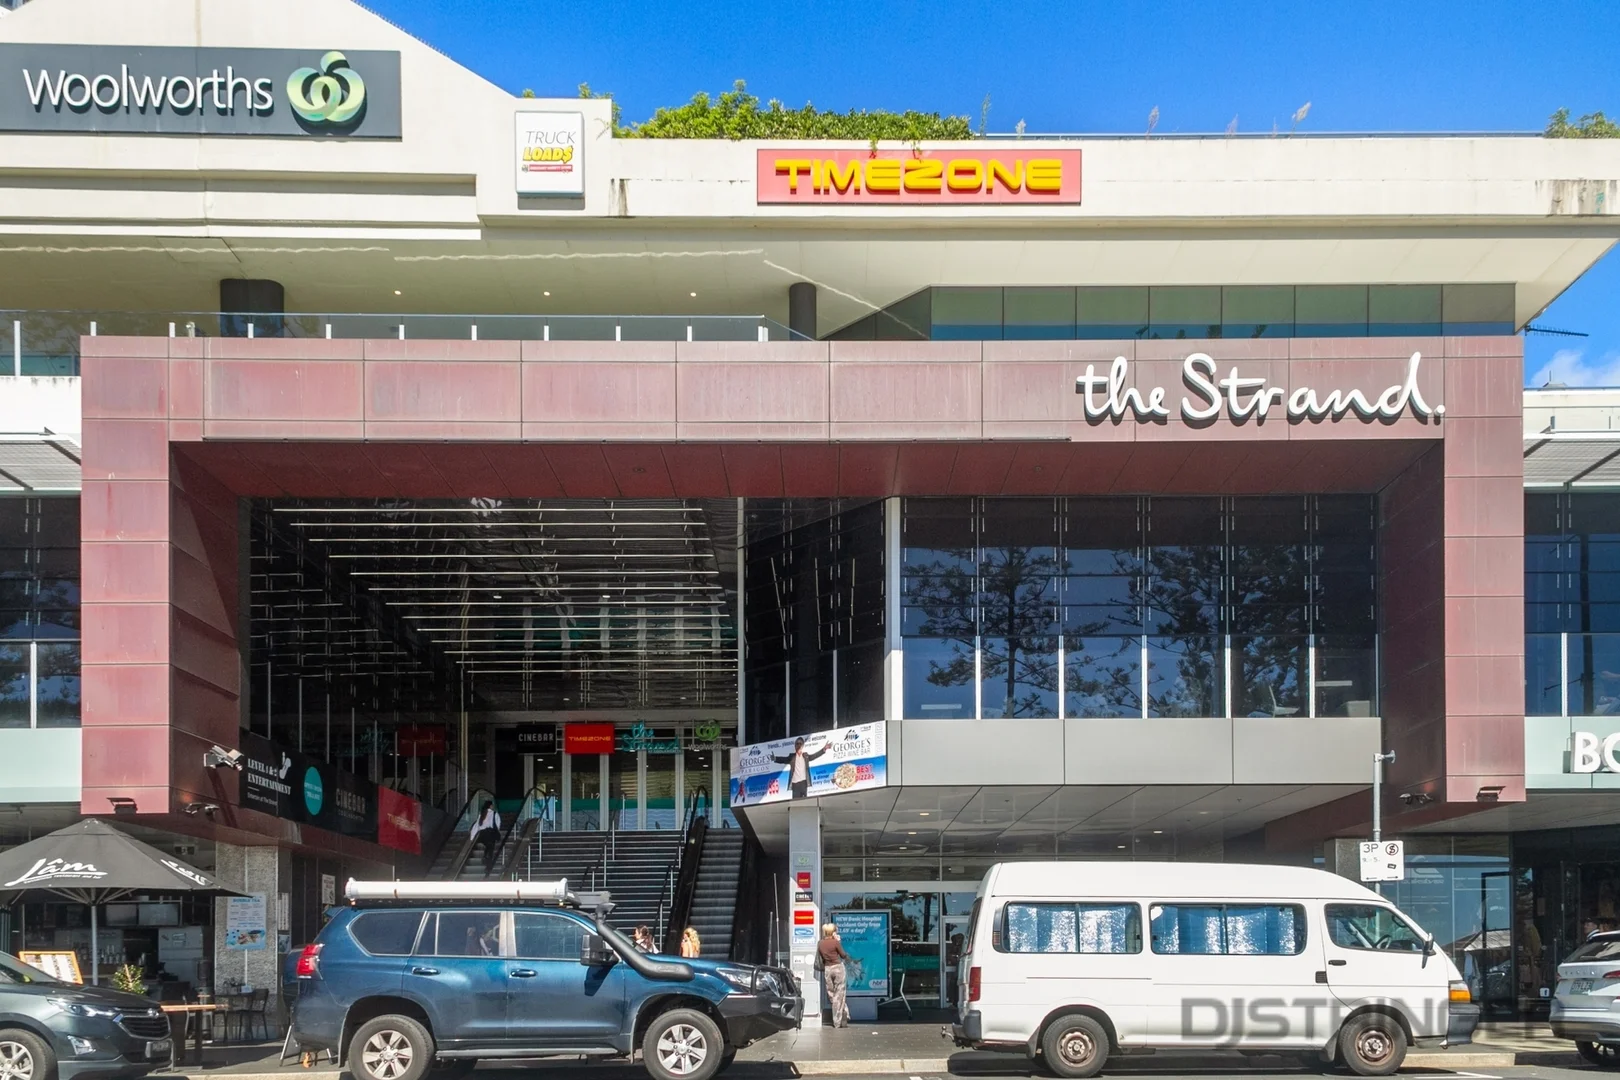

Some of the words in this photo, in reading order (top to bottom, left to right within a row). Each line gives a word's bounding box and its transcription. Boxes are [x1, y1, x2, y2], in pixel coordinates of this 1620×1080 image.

[22, 63, 274, 110] Woolworths
[525, 130, 577, 145] TRUCK
[774, 158, 1062, 194] TIMEZONE
[1076, 355, 1171, 418] the
[518, 733, 554, 742] CINEBAR
[832, 737, 872, 753] GEORGE'S
[739, 753, 772, 768] GEORGE'S
[832, 752, 846, 760] PIZZA
[860, 747, 871, 755] BAR
[247, 757, 266, 773] LEVEL
[741, 765, 770, 774] PARAGON
[856, 763, 873, 774] BEST
[247, 772, 292, 796] ENTERTAINMENT
[1363, 843, 1379, 853] 3P
[861, 915, 882, 923] Hospital
